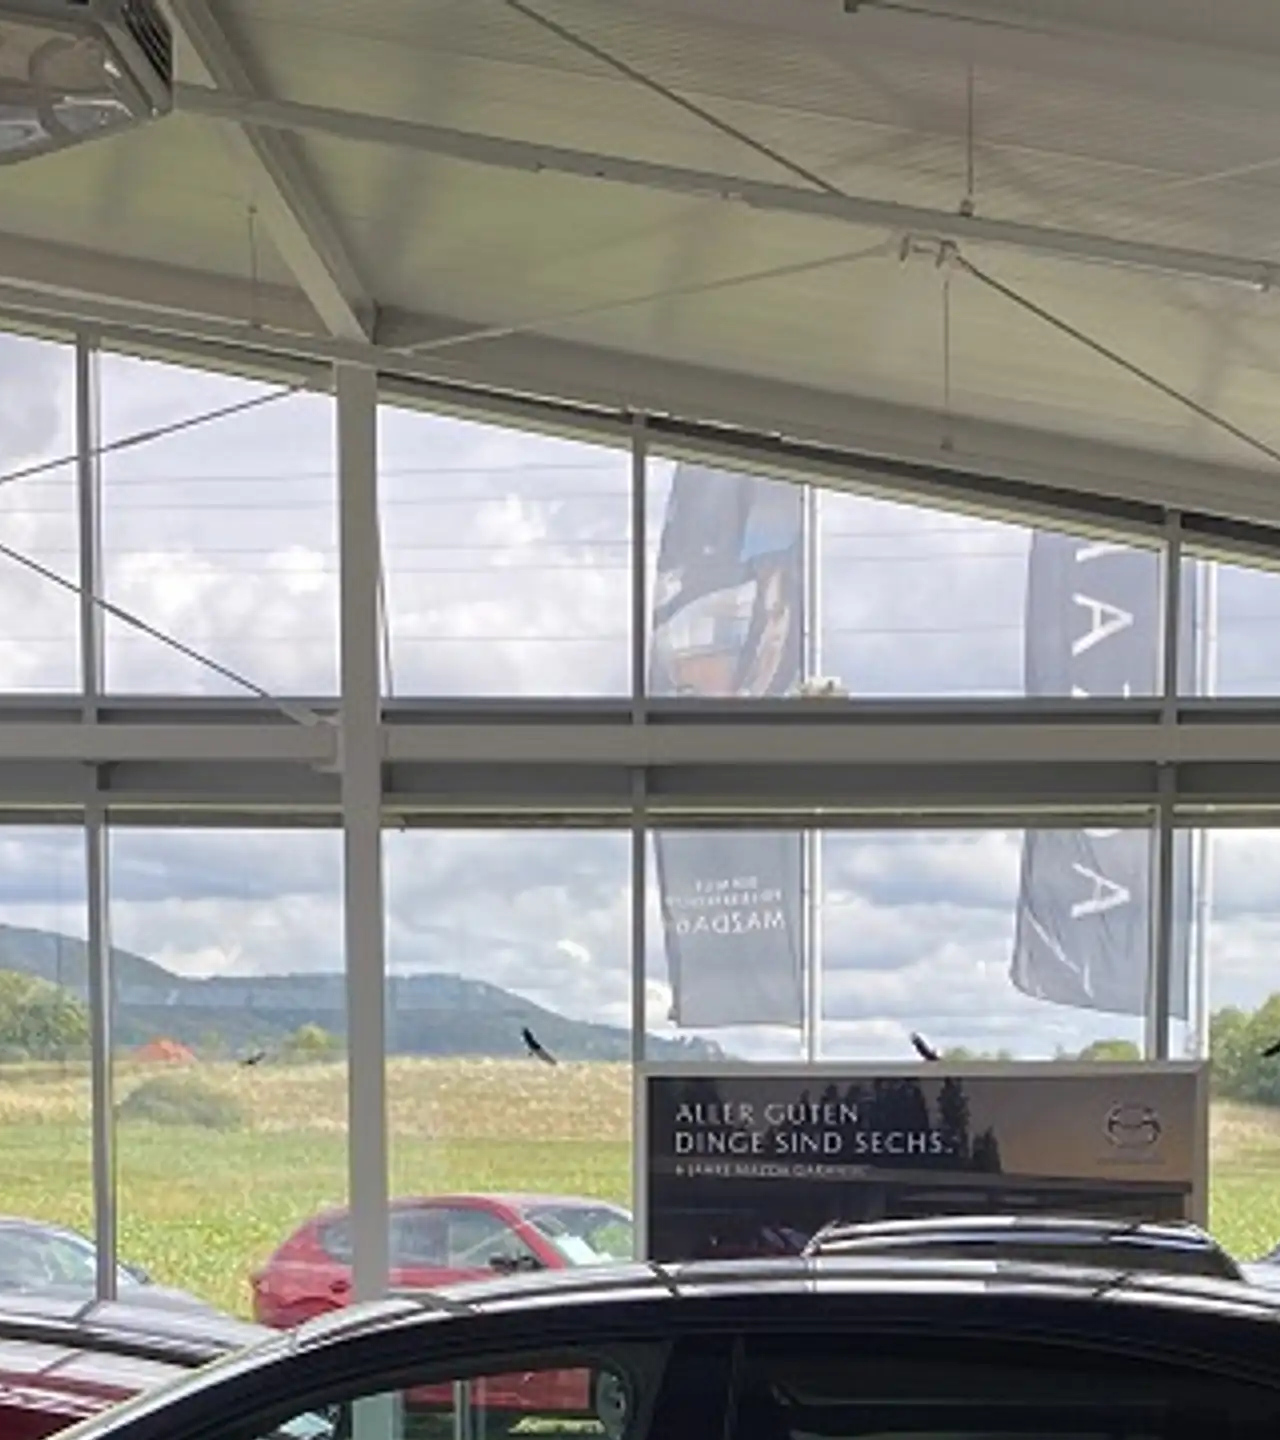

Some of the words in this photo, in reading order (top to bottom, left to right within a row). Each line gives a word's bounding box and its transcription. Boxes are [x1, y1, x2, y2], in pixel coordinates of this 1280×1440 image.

[675, 1103, 754, 1125] ALLER
[764, 1103, 858, 1125] GUTEN
[675, 1131, 764, 1153] DINGE
[775, 1131, 842, 1153] SIND
[855, 1131, 953, 1153] SECHS.
